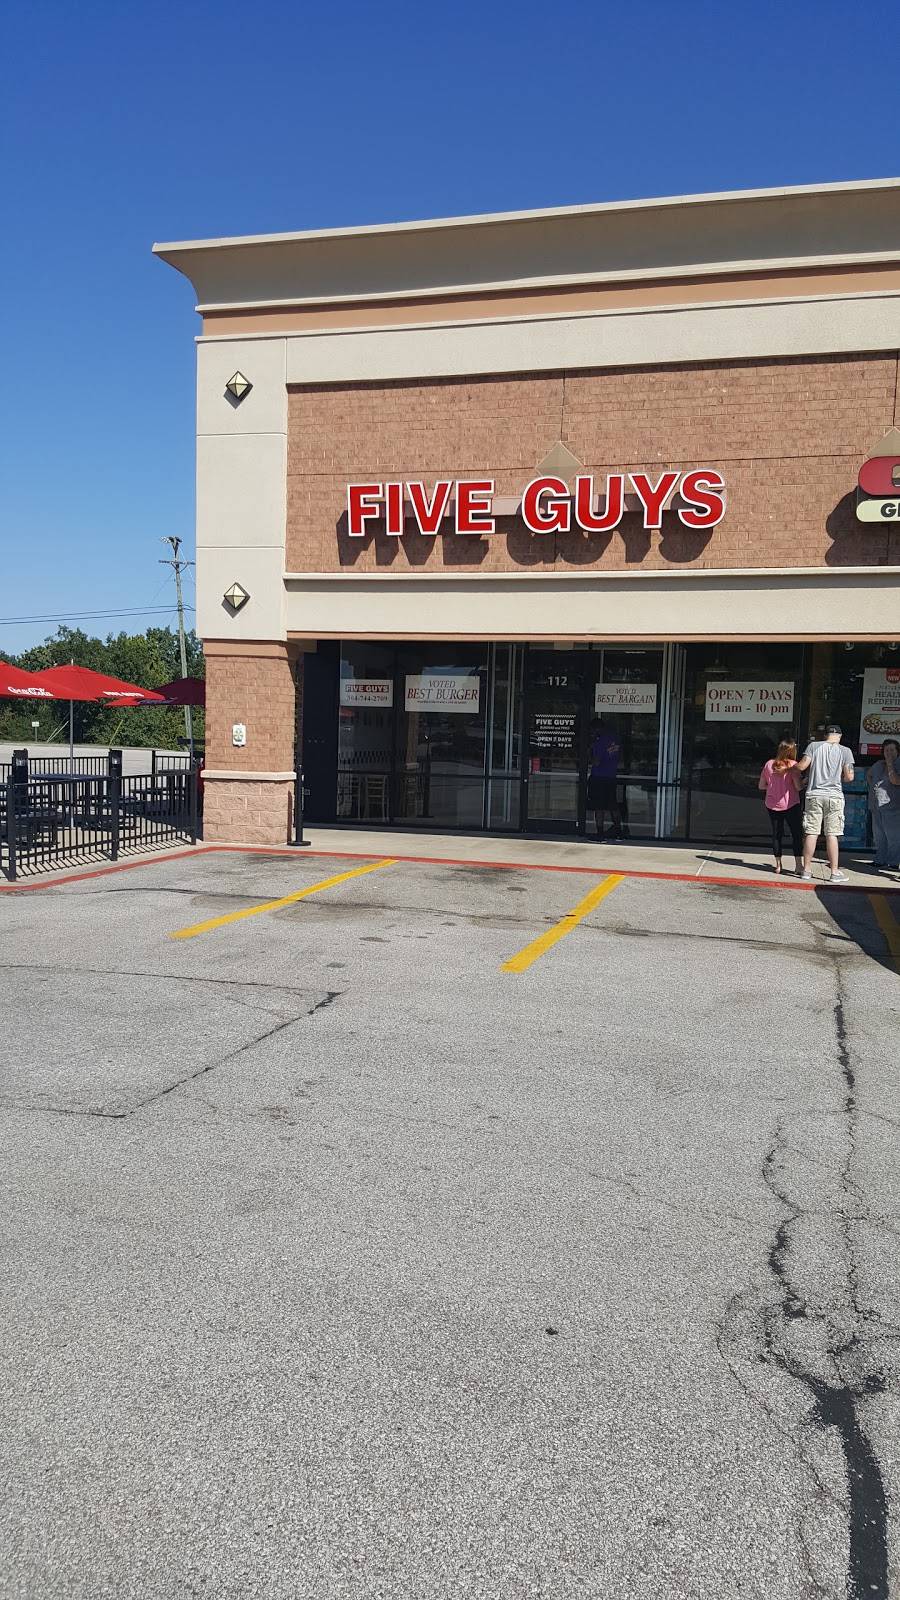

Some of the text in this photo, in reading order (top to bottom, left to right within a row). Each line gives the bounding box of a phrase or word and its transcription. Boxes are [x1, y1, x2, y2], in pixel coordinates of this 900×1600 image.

[347, 469, 727, 537] FIVE GUYS
[880, 502, 900, 518] G
[429, 680, 456, 688] VOTED
[547, 676, 568, 686] 112
[407, 688, 479, 700] BEST BURGER
[597, 695, 655, 704] BEST BARGAIN
[708, 689, 792, 700] OPEN 7 DAYS
[710, 703, 720, 713] 11
[724, 704, 742, 712] am
[756, 703, 767, 713] 10
[769, 704, 789, 715] pm
